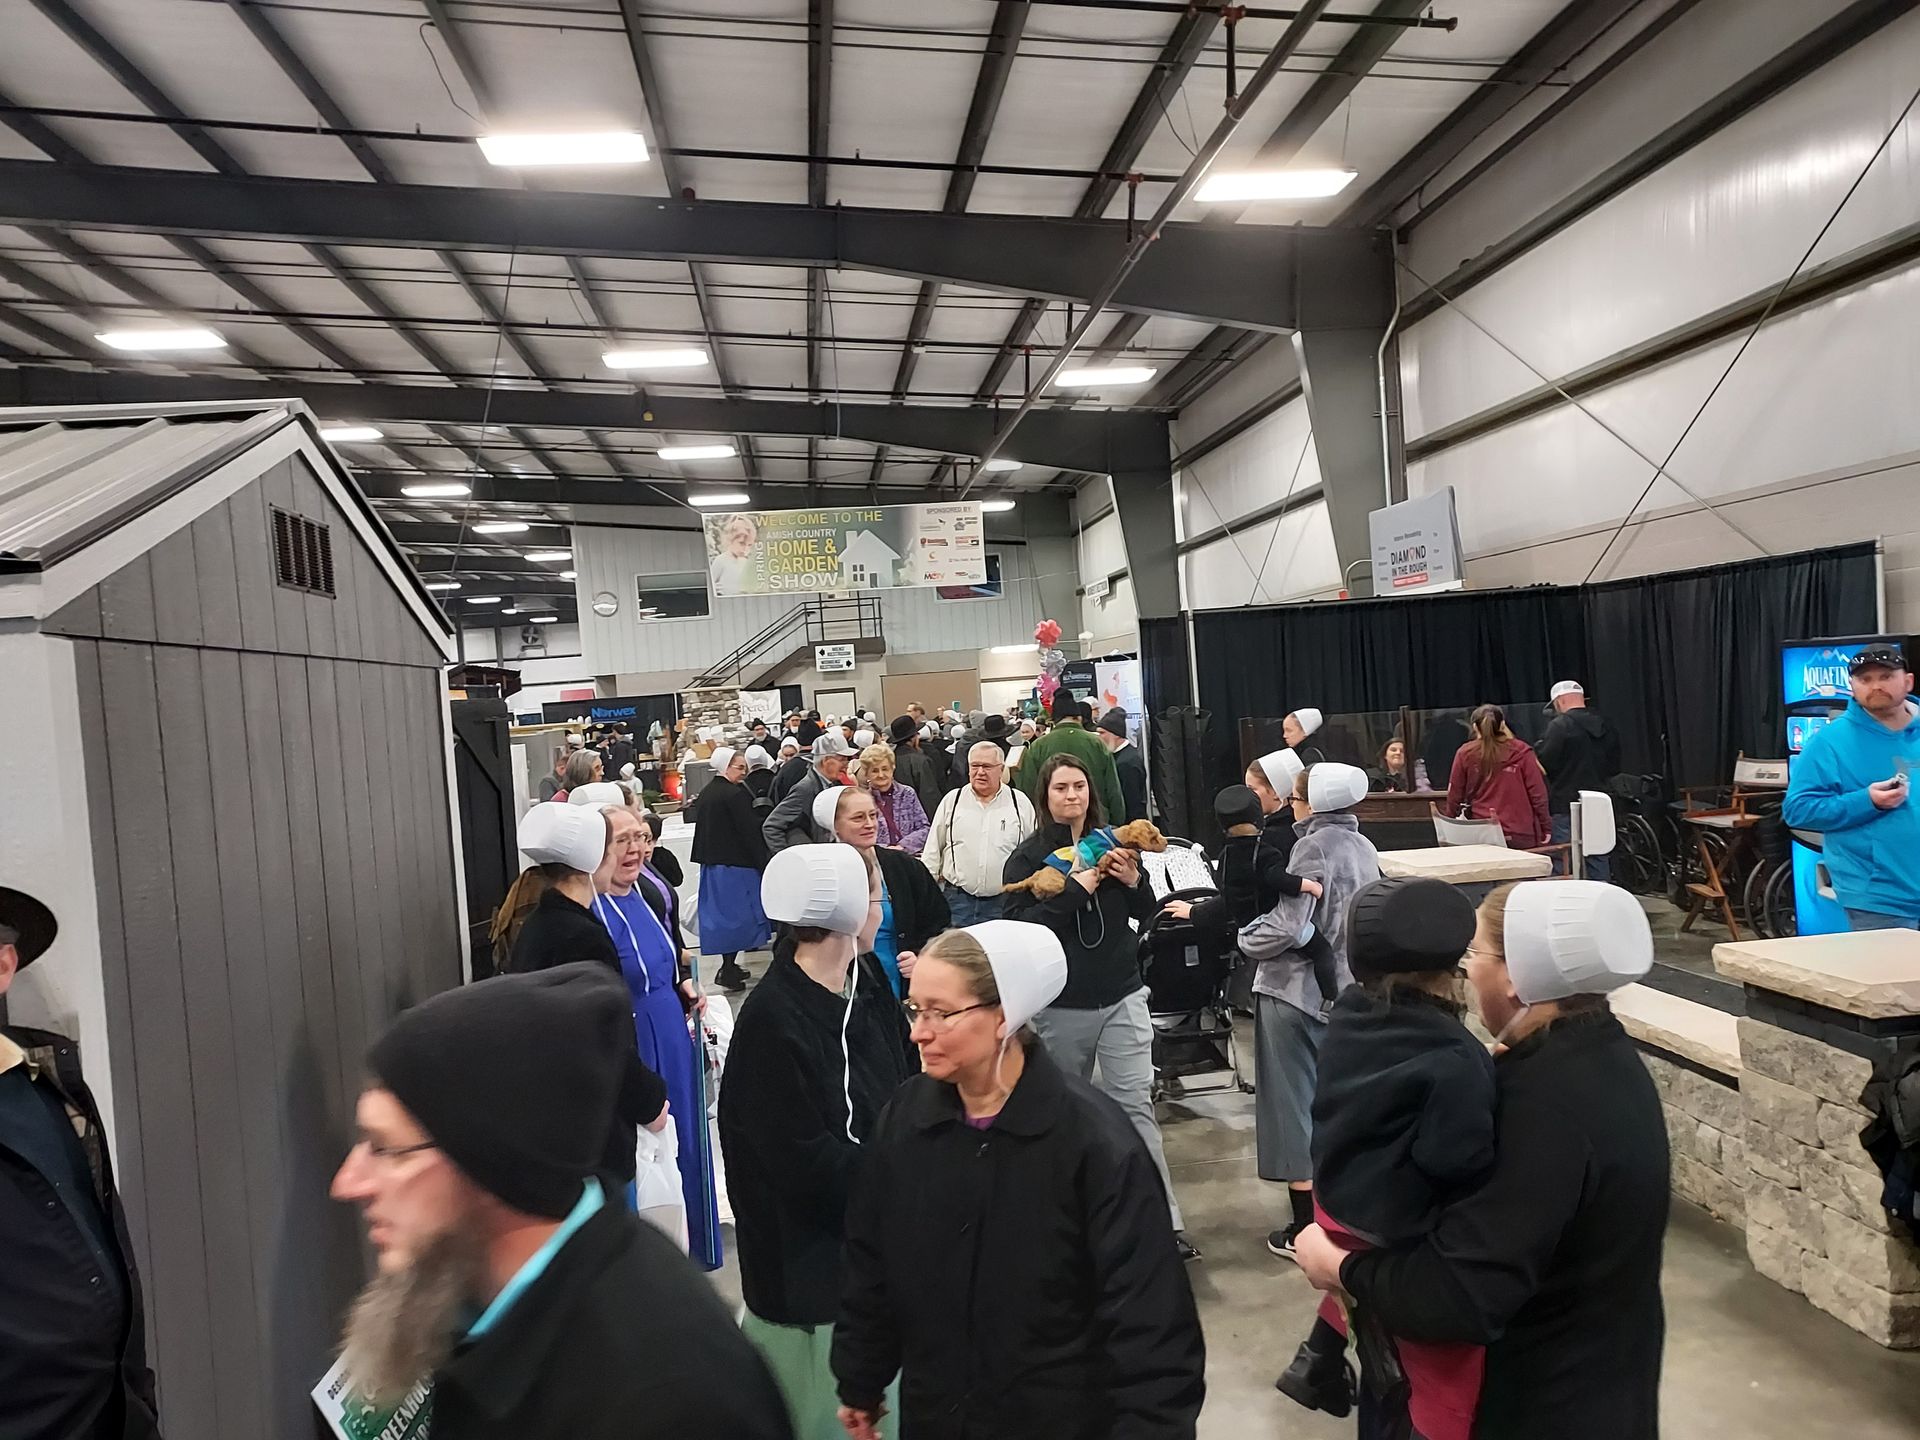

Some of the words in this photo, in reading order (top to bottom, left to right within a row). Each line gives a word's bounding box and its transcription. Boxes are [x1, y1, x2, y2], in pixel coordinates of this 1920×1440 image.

[755, 512, 828, 527] WELCOME
[833, 512, 854, 523] TO
[857, 510, 883, 522] THE
[926, 506, 962, 514] SPONSORED
[766, 529, 794, 539] AMISH
[795, 527, 837, 538] COUNTRY
[766, 539, 819, 556] HOME
[824, 537, 837, 554] &
[754, 541, 766, 589] SPRING
[768, 555, 839, 574] GARDEN
[1391, 567, 1398, 577] IN
[1398, 565, 1409, 575] THE
[1409, 562, 1428, 573] ROUGH
[768, 572, 838, 589] SHOW
[1802, 663, 1852, 694] AQUAFIN
[591, 707, 637, 718] Norwex
